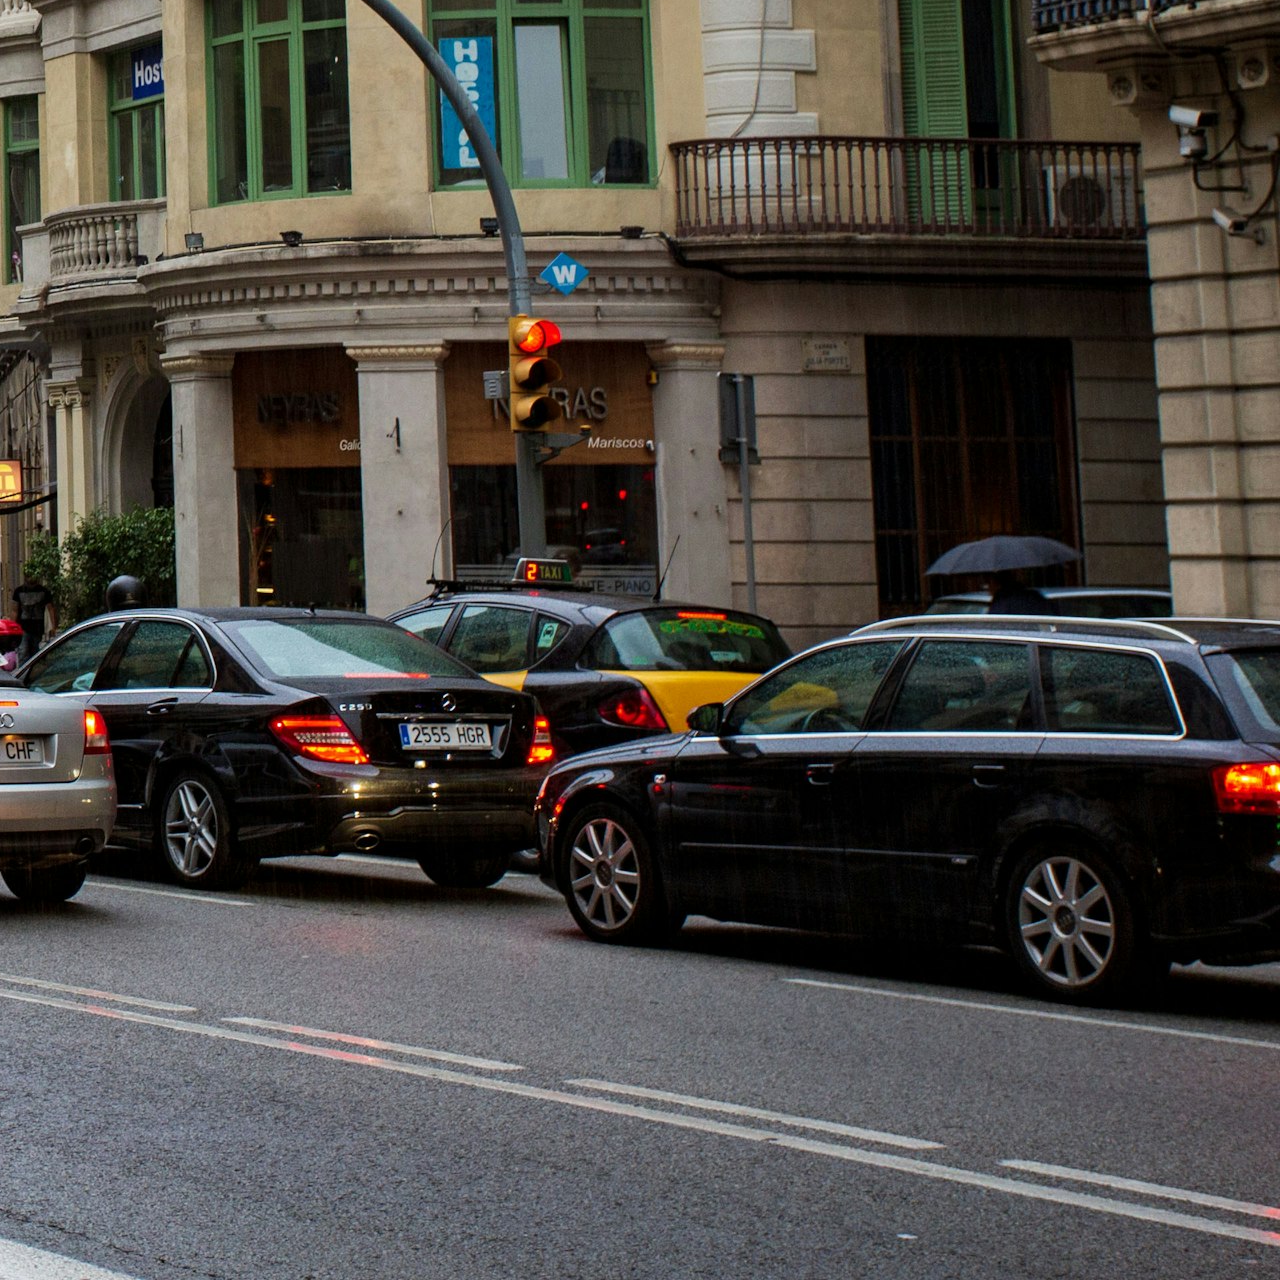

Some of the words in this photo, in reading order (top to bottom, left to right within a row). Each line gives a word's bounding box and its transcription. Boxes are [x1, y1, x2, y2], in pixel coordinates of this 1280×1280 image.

[551, 264, 578, 284] W
[493, 387, 609, 420] NRAS
[588, 437, 645, 449] Mariscos
[539, 565, 562, 579] TAXI
[614, 581, 652, 593] PIANO
[411, 726, 451, 743] 2555
[456, 727, 486, 744] HGR
[5, 741, 35, 760] CHF
